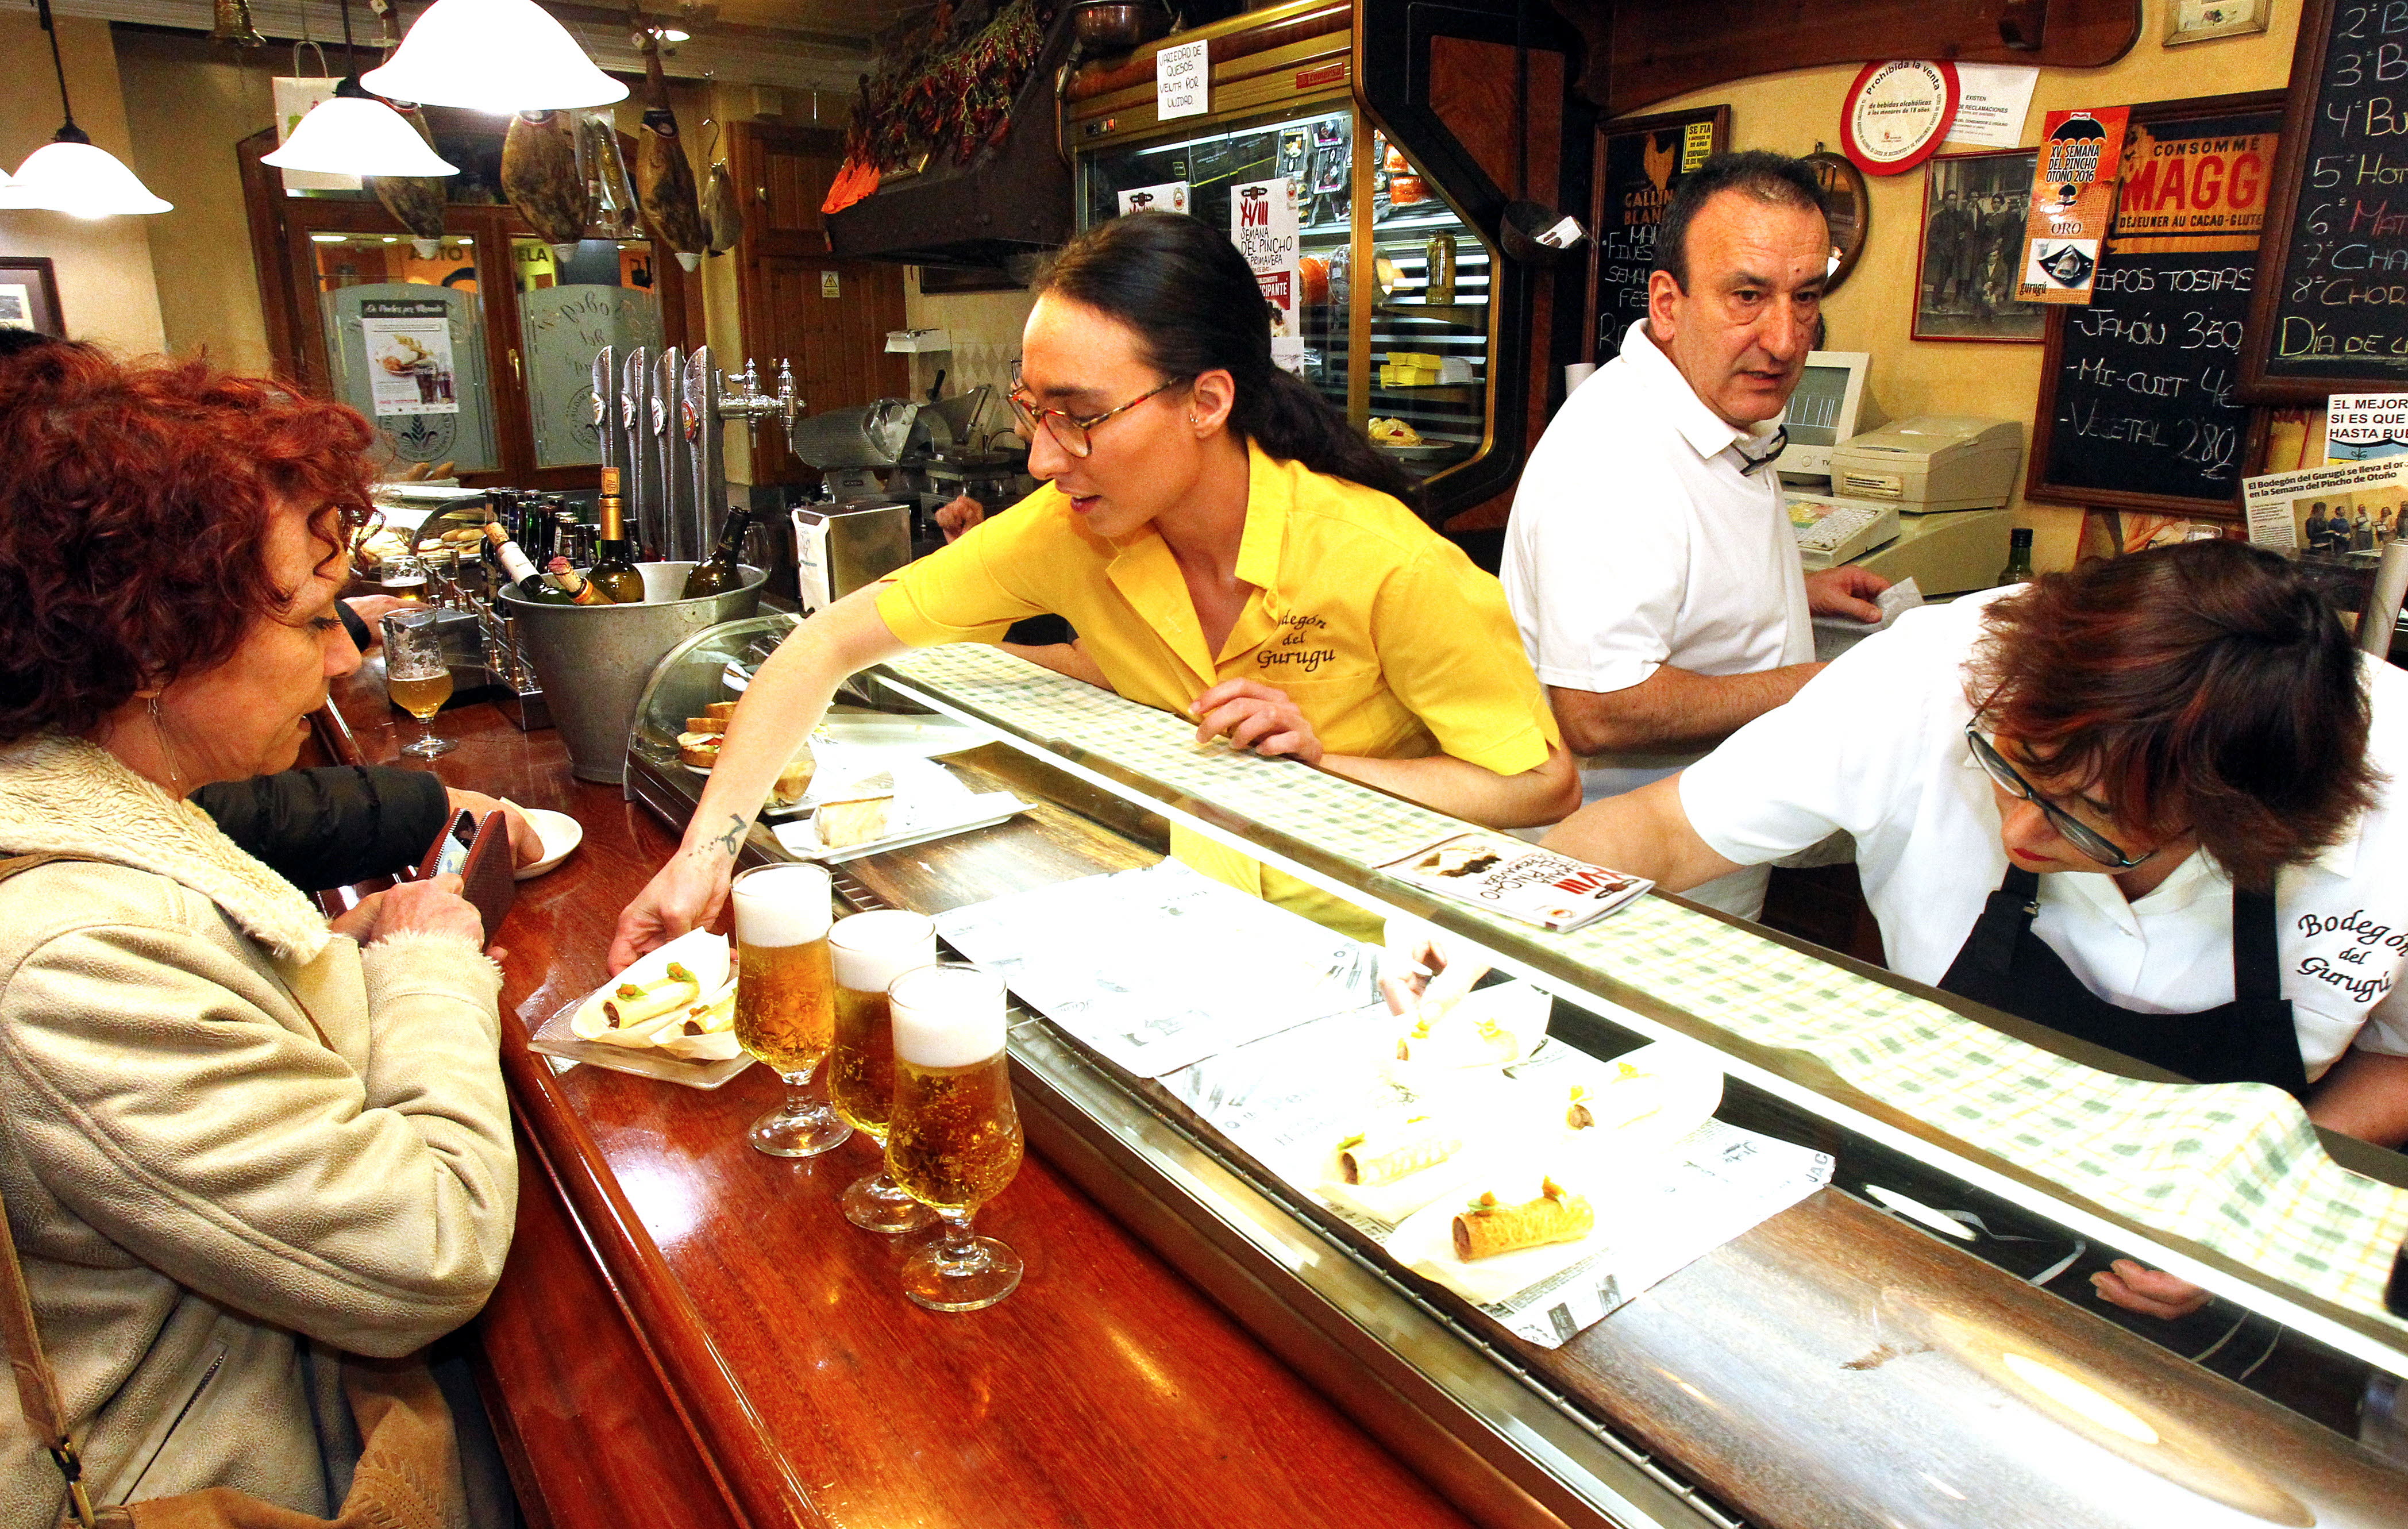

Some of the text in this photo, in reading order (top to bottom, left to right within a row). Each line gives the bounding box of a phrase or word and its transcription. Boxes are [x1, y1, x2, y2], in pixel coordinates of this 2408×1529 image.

[1159, 45, 1201, 66] VARIEDAD DE
[1166, 60, 1193, 76] QUESOS
[1185, 76, 1199, 89] POR
[1867, 60, 1940, 95] Prohibida la venta
[1965, 105, 2008, 113] RECLAMACIONES
[1689, 126, 1698, 134] SE
[2051, 145, 2099, 157] XV SEMANA
[2048, 157, 2097, 170] DEL PINCHO
[2074, 170, 2095, 182] 2016
[1625, 190, 1673, 207] GALLIN
[1240, 198, 1268, 227] XVIII
[1624, 208, 1662, 225] BLAN
[2051, 222, 2082, 234] ORO
[2172, 216, 2186, 226] AU
[1240, 227, 1269, 241] SEMANA
[1241, 236, 1293, 256] DEL PINCHO
[1251, 255, 1282, 266] PRIMAVERA
[1261, 282, 1287, 296] CIPANTE
[2345, 335, 2384, 353] DE
[2333, 399, 2408, 409] EL MEJOR
[2331, 414, 2405, 424] SI ES QUE
[2329, 429, 2378, 438] HASTA
[2257, 477, 2295, 488] Bodegón
[2297, 474, 2311, 483] del
[2313, 469, 2345, 481] Gurugú
[2359, 463, 2381, 473] lleva
[2270, 484, 2305, 496] Semana
[2306, 482, 2320, 490] del
[2321, 477, 2352, 488] Pincho
[2367, 471, 2397, 481] Otoño
[1278, 608, 1327, 630] degón
[1282, 630, 1307, 646] del
[2338, 947, 2372, 965] del
